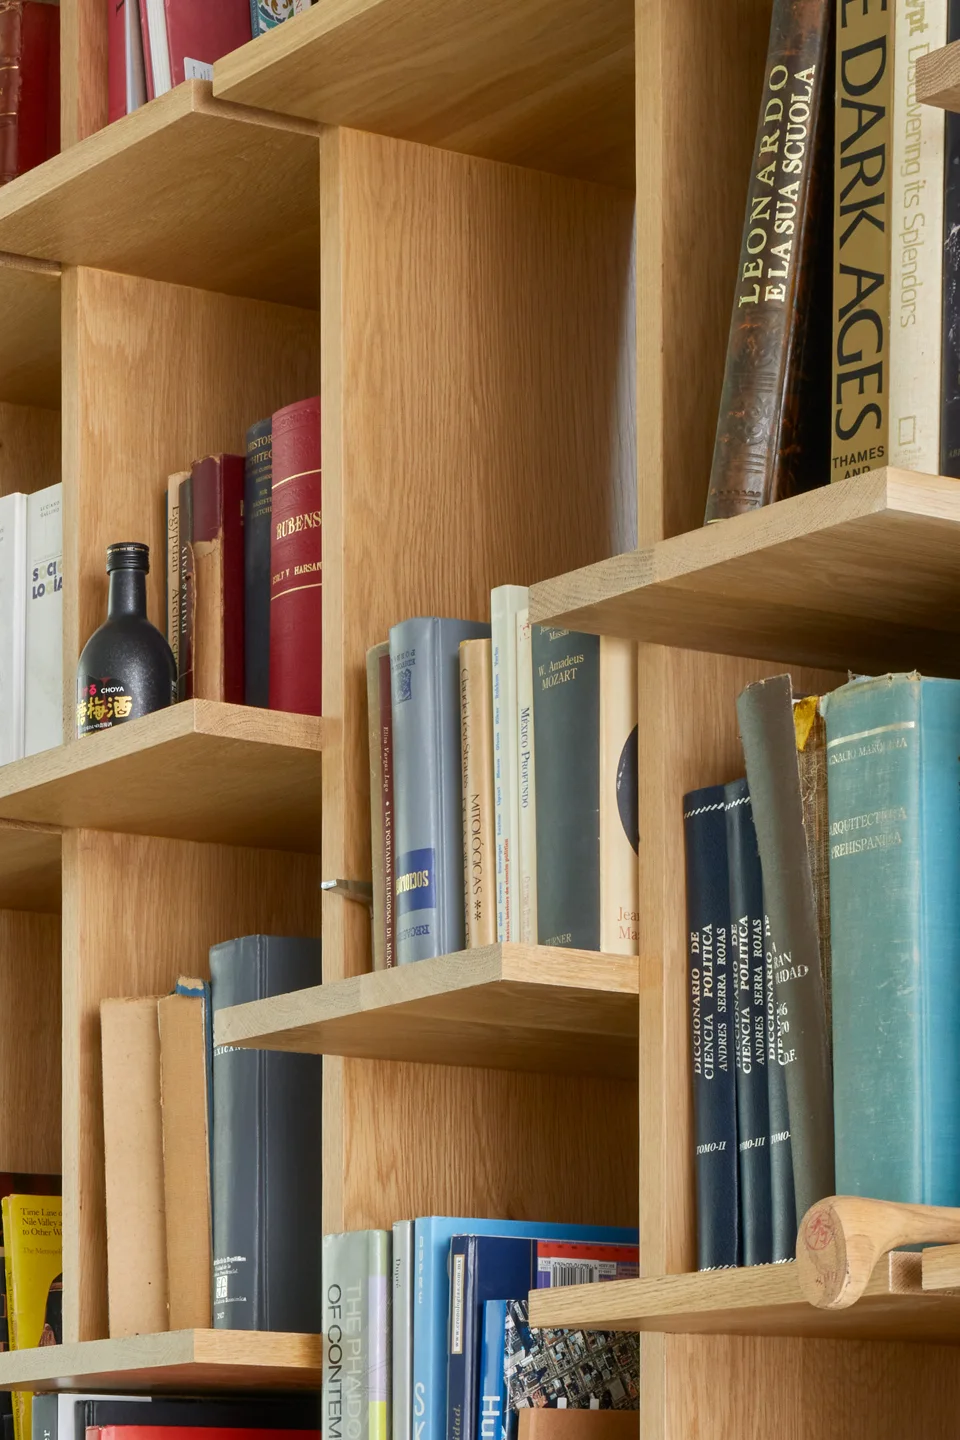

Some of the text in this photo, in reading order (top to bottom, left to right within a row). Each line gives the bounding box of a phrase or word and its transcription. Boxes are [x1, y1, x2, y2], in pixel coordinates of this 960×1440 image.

[782, 65, 817, 174] SCUOLA
[839, 35, 887, 249] DARK
[740, 64, 790, 308] LEONARDO
[900, 212, 926, 329] Splendors
[835, 268, 887, 441] AGES
[832, 445, 885, 469] THAMES
[168, 505, 180, 573] Egyptian
[276, 510, 322, 540] RUBENS
[101, 686, 124, 694] CHOYA
[541, 668, 577, 690] MOZART
[549, 654, 584, 673] Amadeus
[521, 751, 531, 808] PROFUNDO
[470, 794, 484, 895] MITOLÓGICAS
[691, 967, 702, 1075] DICCIONARIO
[702, 923, 714, 1080] CIENCIA POLITICA
[716, 927, 728, 1071] ANDRES ROJAS
[739, 914, 752, 1074] CIENCIA POLITICA
[20, 1208, 39, 1217] Time
[30, 1227, 50, 1237] Other
[36, 1217, 55, 1229] Valley
[327, 1283, 342, 1320] OF
[346, 1286, 361, 1337] THE
